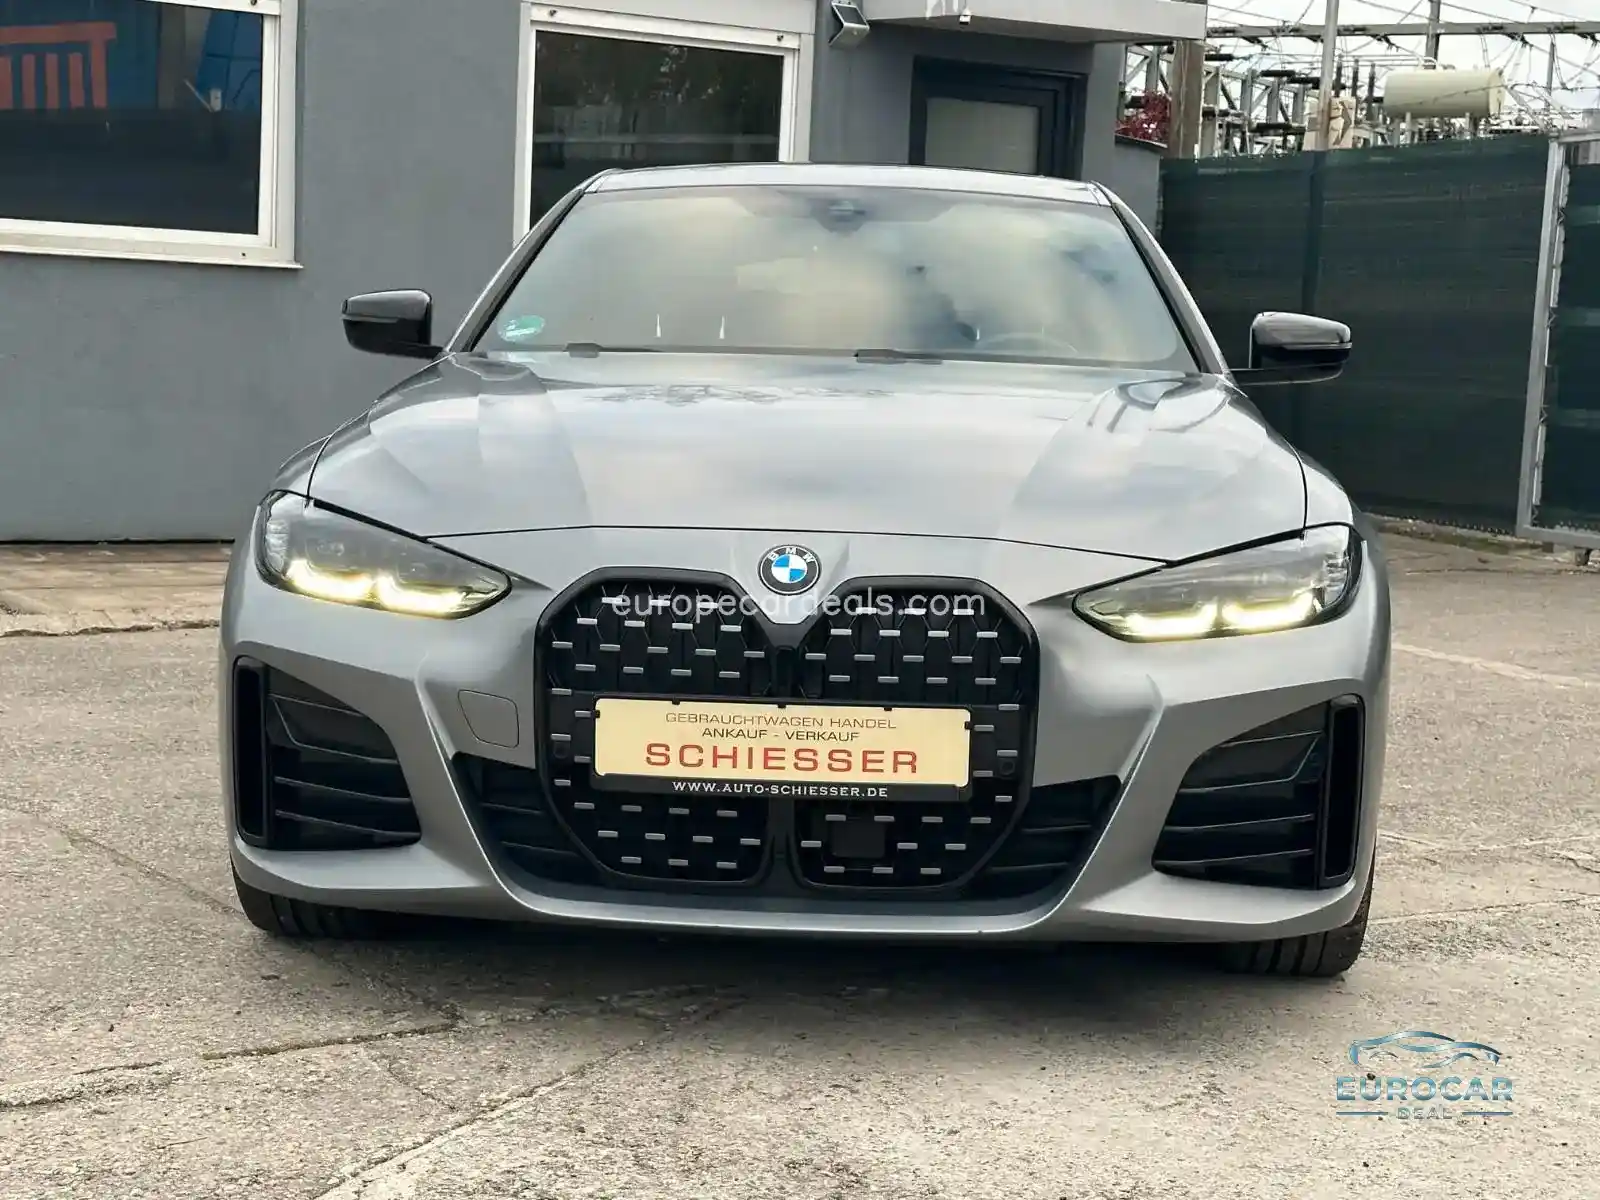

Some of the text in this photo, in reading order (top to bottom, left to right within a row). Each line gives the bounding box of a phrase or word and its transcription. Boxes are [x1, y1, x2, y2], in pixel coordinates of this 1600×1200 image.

[767, 547, 816, 563] BMW
[665, 712, 897, 730] GEBRAUCHTWAGEN HANDEL
[701, 727, 768, 740] ANKAUF
[784, 729, 861, 743] VERKAUF
[645, 742, 918, 775] SCHIESSER
[672, 780, 889, 798] WWW.AUTO-SCHIESSER.DE
